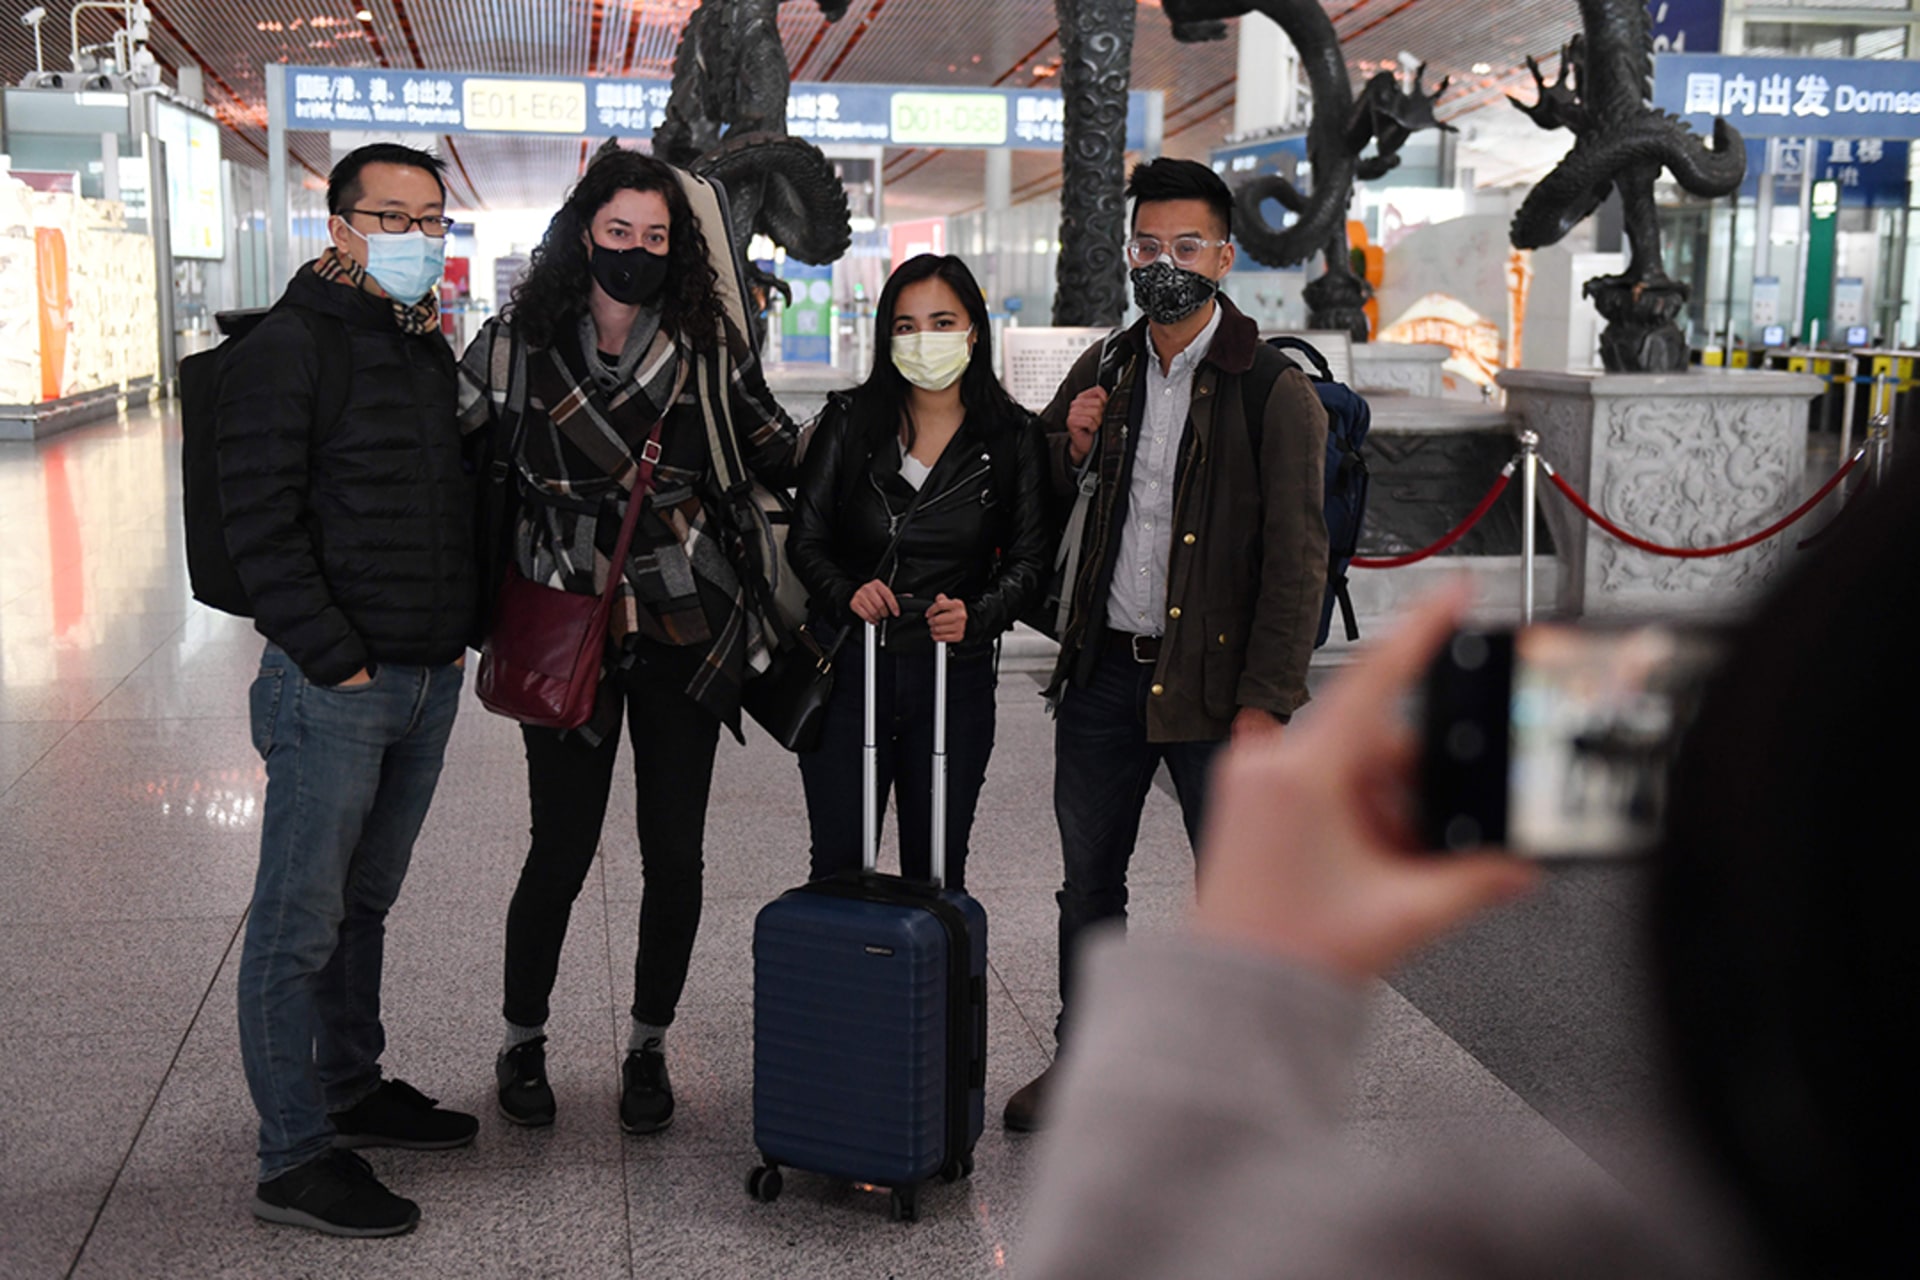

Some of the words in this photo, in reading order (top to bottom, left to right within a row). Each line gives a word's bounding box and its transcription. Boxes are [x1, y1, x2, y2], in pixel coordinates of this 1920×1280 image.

[470, 90, 580, 121] E01-E62
[1684, 73, 1830, 117] 国内出发
[898, 105, 1001, 132] D01-D58
